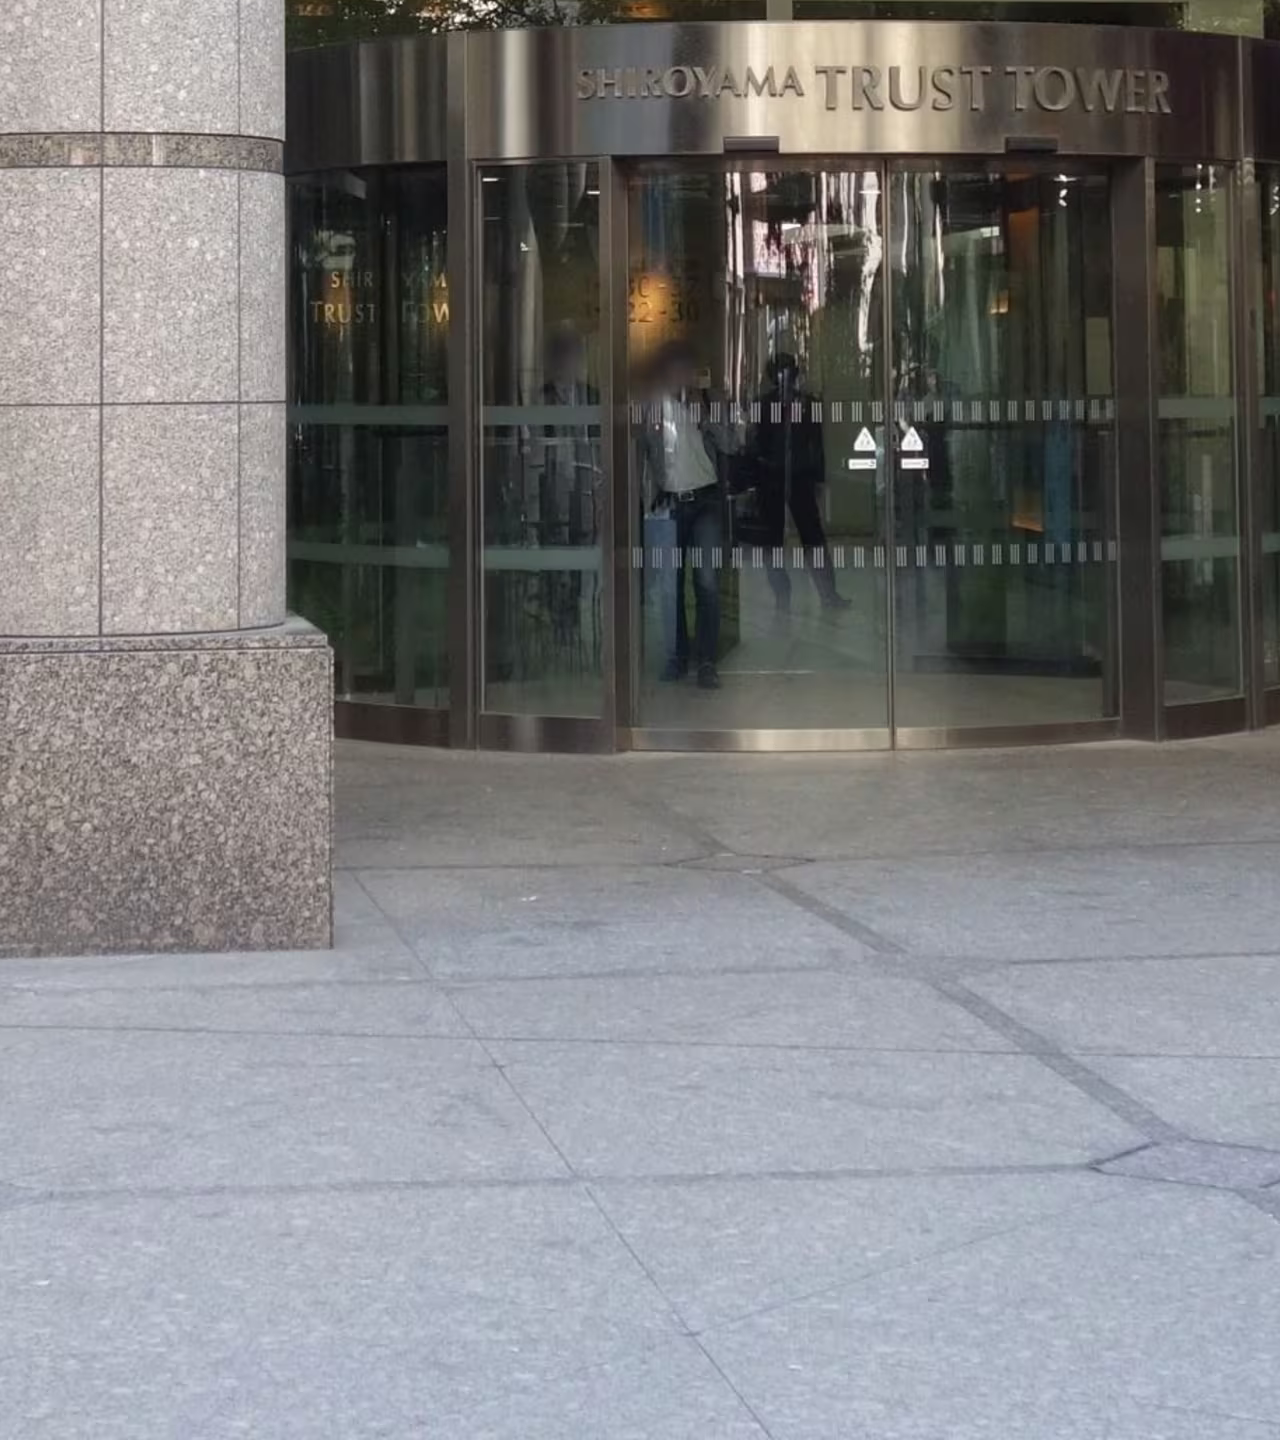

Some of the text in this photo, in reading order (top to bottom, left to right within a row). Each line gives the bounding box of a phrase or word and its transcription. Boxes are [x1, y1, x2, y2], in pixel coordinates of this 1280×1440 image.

[576, 65, 1171, 114] SHIROYAMA TRUST TOWER
[309, 300, 376, 324] TRUST
